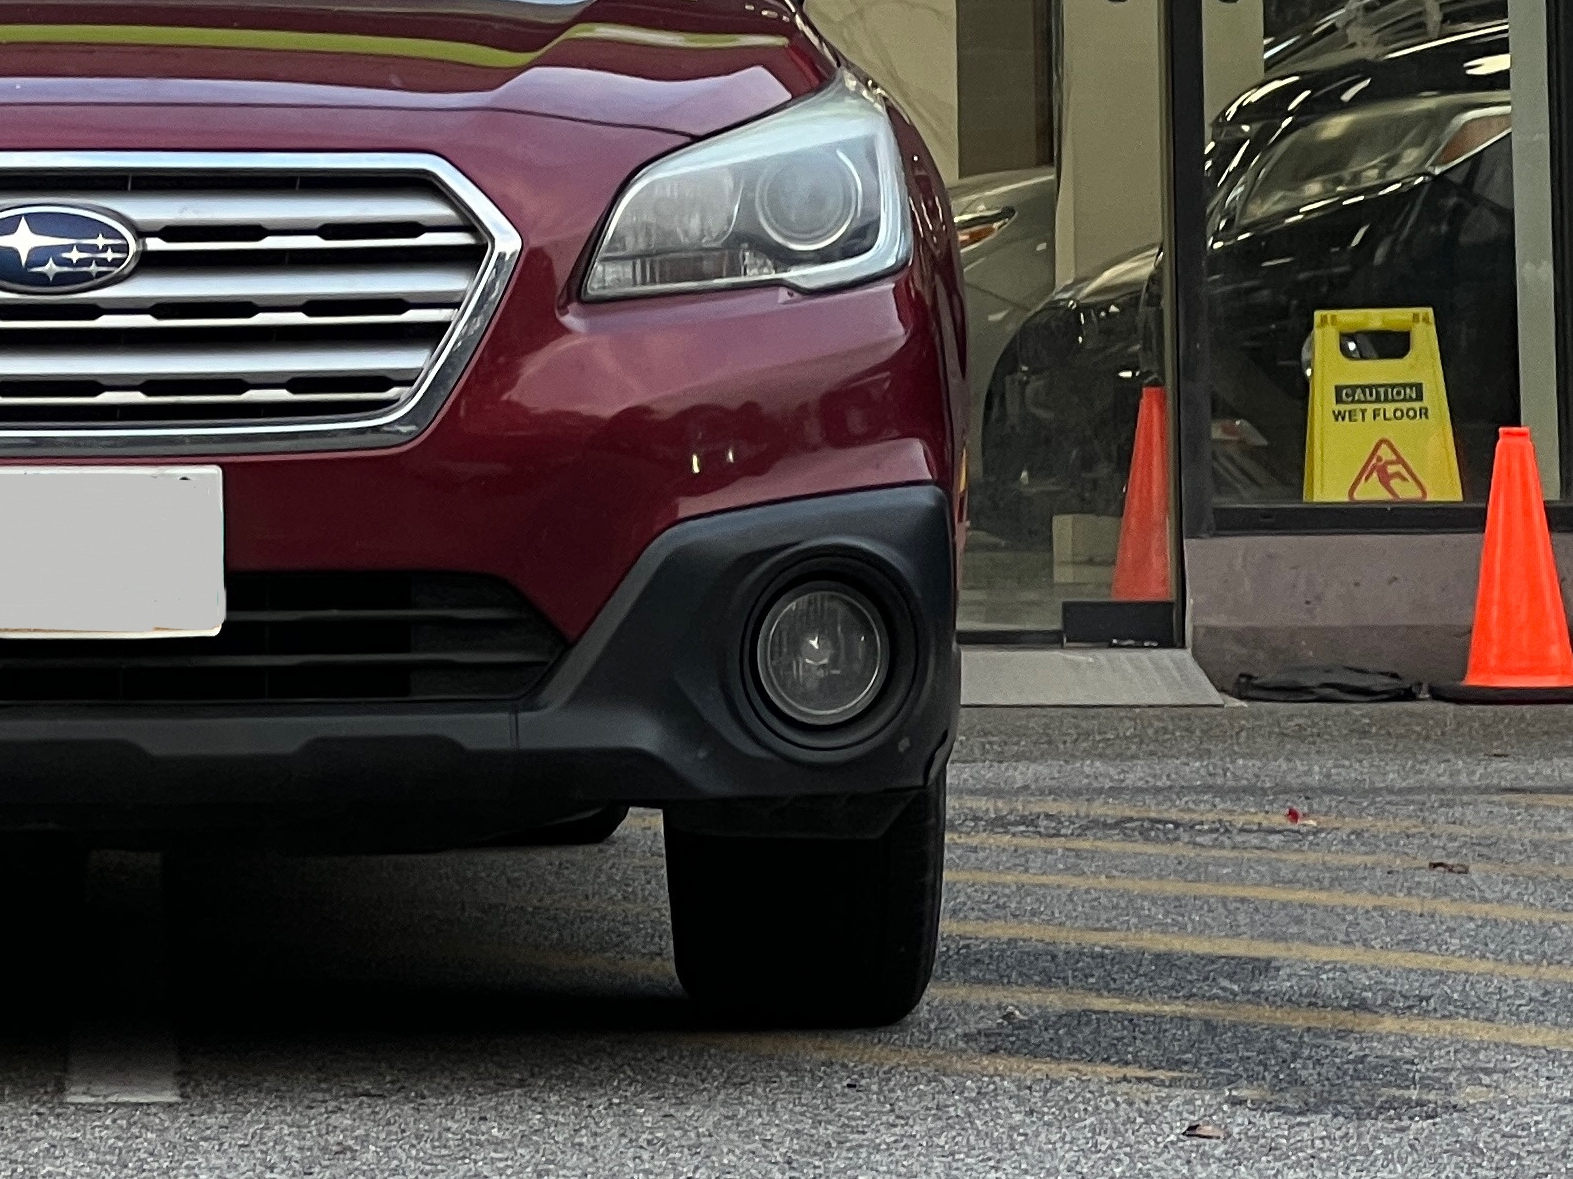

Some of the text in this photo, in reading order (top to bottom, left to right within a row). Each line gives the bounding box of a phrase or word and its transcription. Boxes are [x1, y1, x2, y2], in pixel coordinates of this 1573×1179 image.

[1341, 386, 1417, 402] CAUTION
[1332, 406, 1430, 423] WET FLOOR
